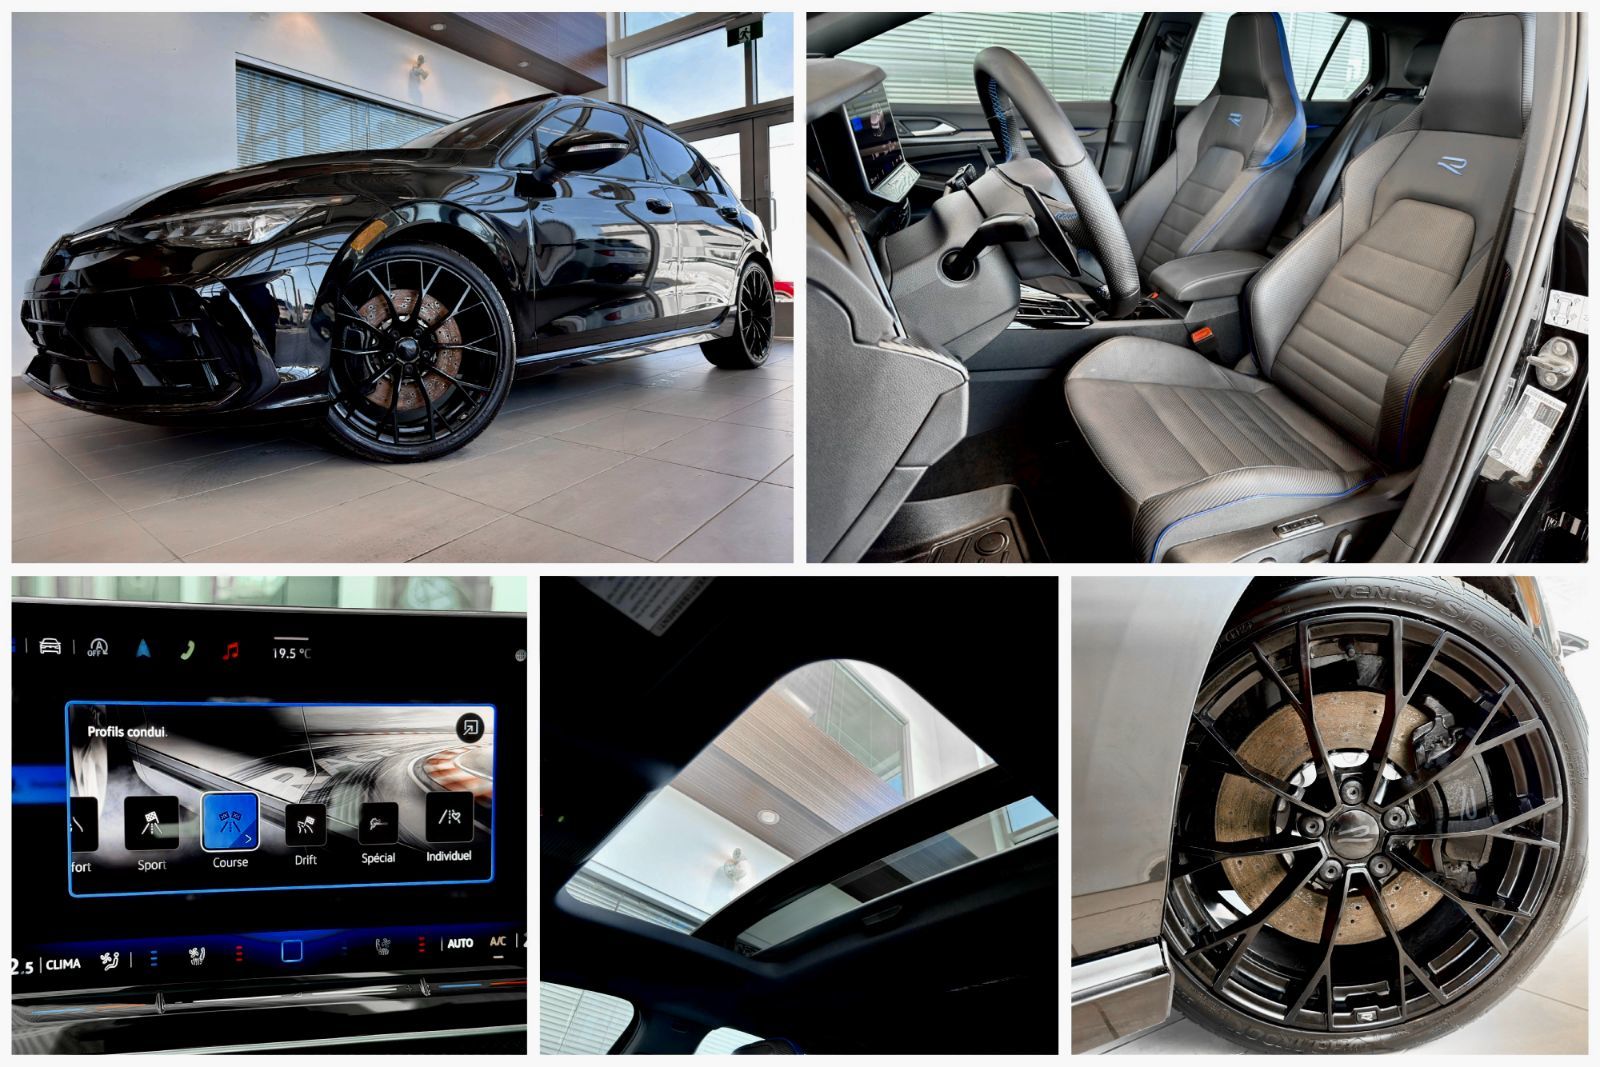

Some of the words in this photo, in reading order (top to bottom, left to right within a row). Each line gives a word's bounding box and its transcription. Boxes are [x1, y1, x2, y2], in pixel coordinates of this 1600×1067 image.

[87, 649, 102, 657] OFF
[273, 647, 296, 659] 19.5
[87, 725, 125, 738] Profils
[212, 856, 249, 868] Course
[295, 854, 318, 866] Drift
[361, 852, 396, 866] Spécial
[426, 850, 472, 862] Individuel
[137, 859, 168, 873] Sport
[447, 937, 474, 949] AUTO
[489, 935, 507, 947] A/C
[45, 957, 81, 971] CLIMA
